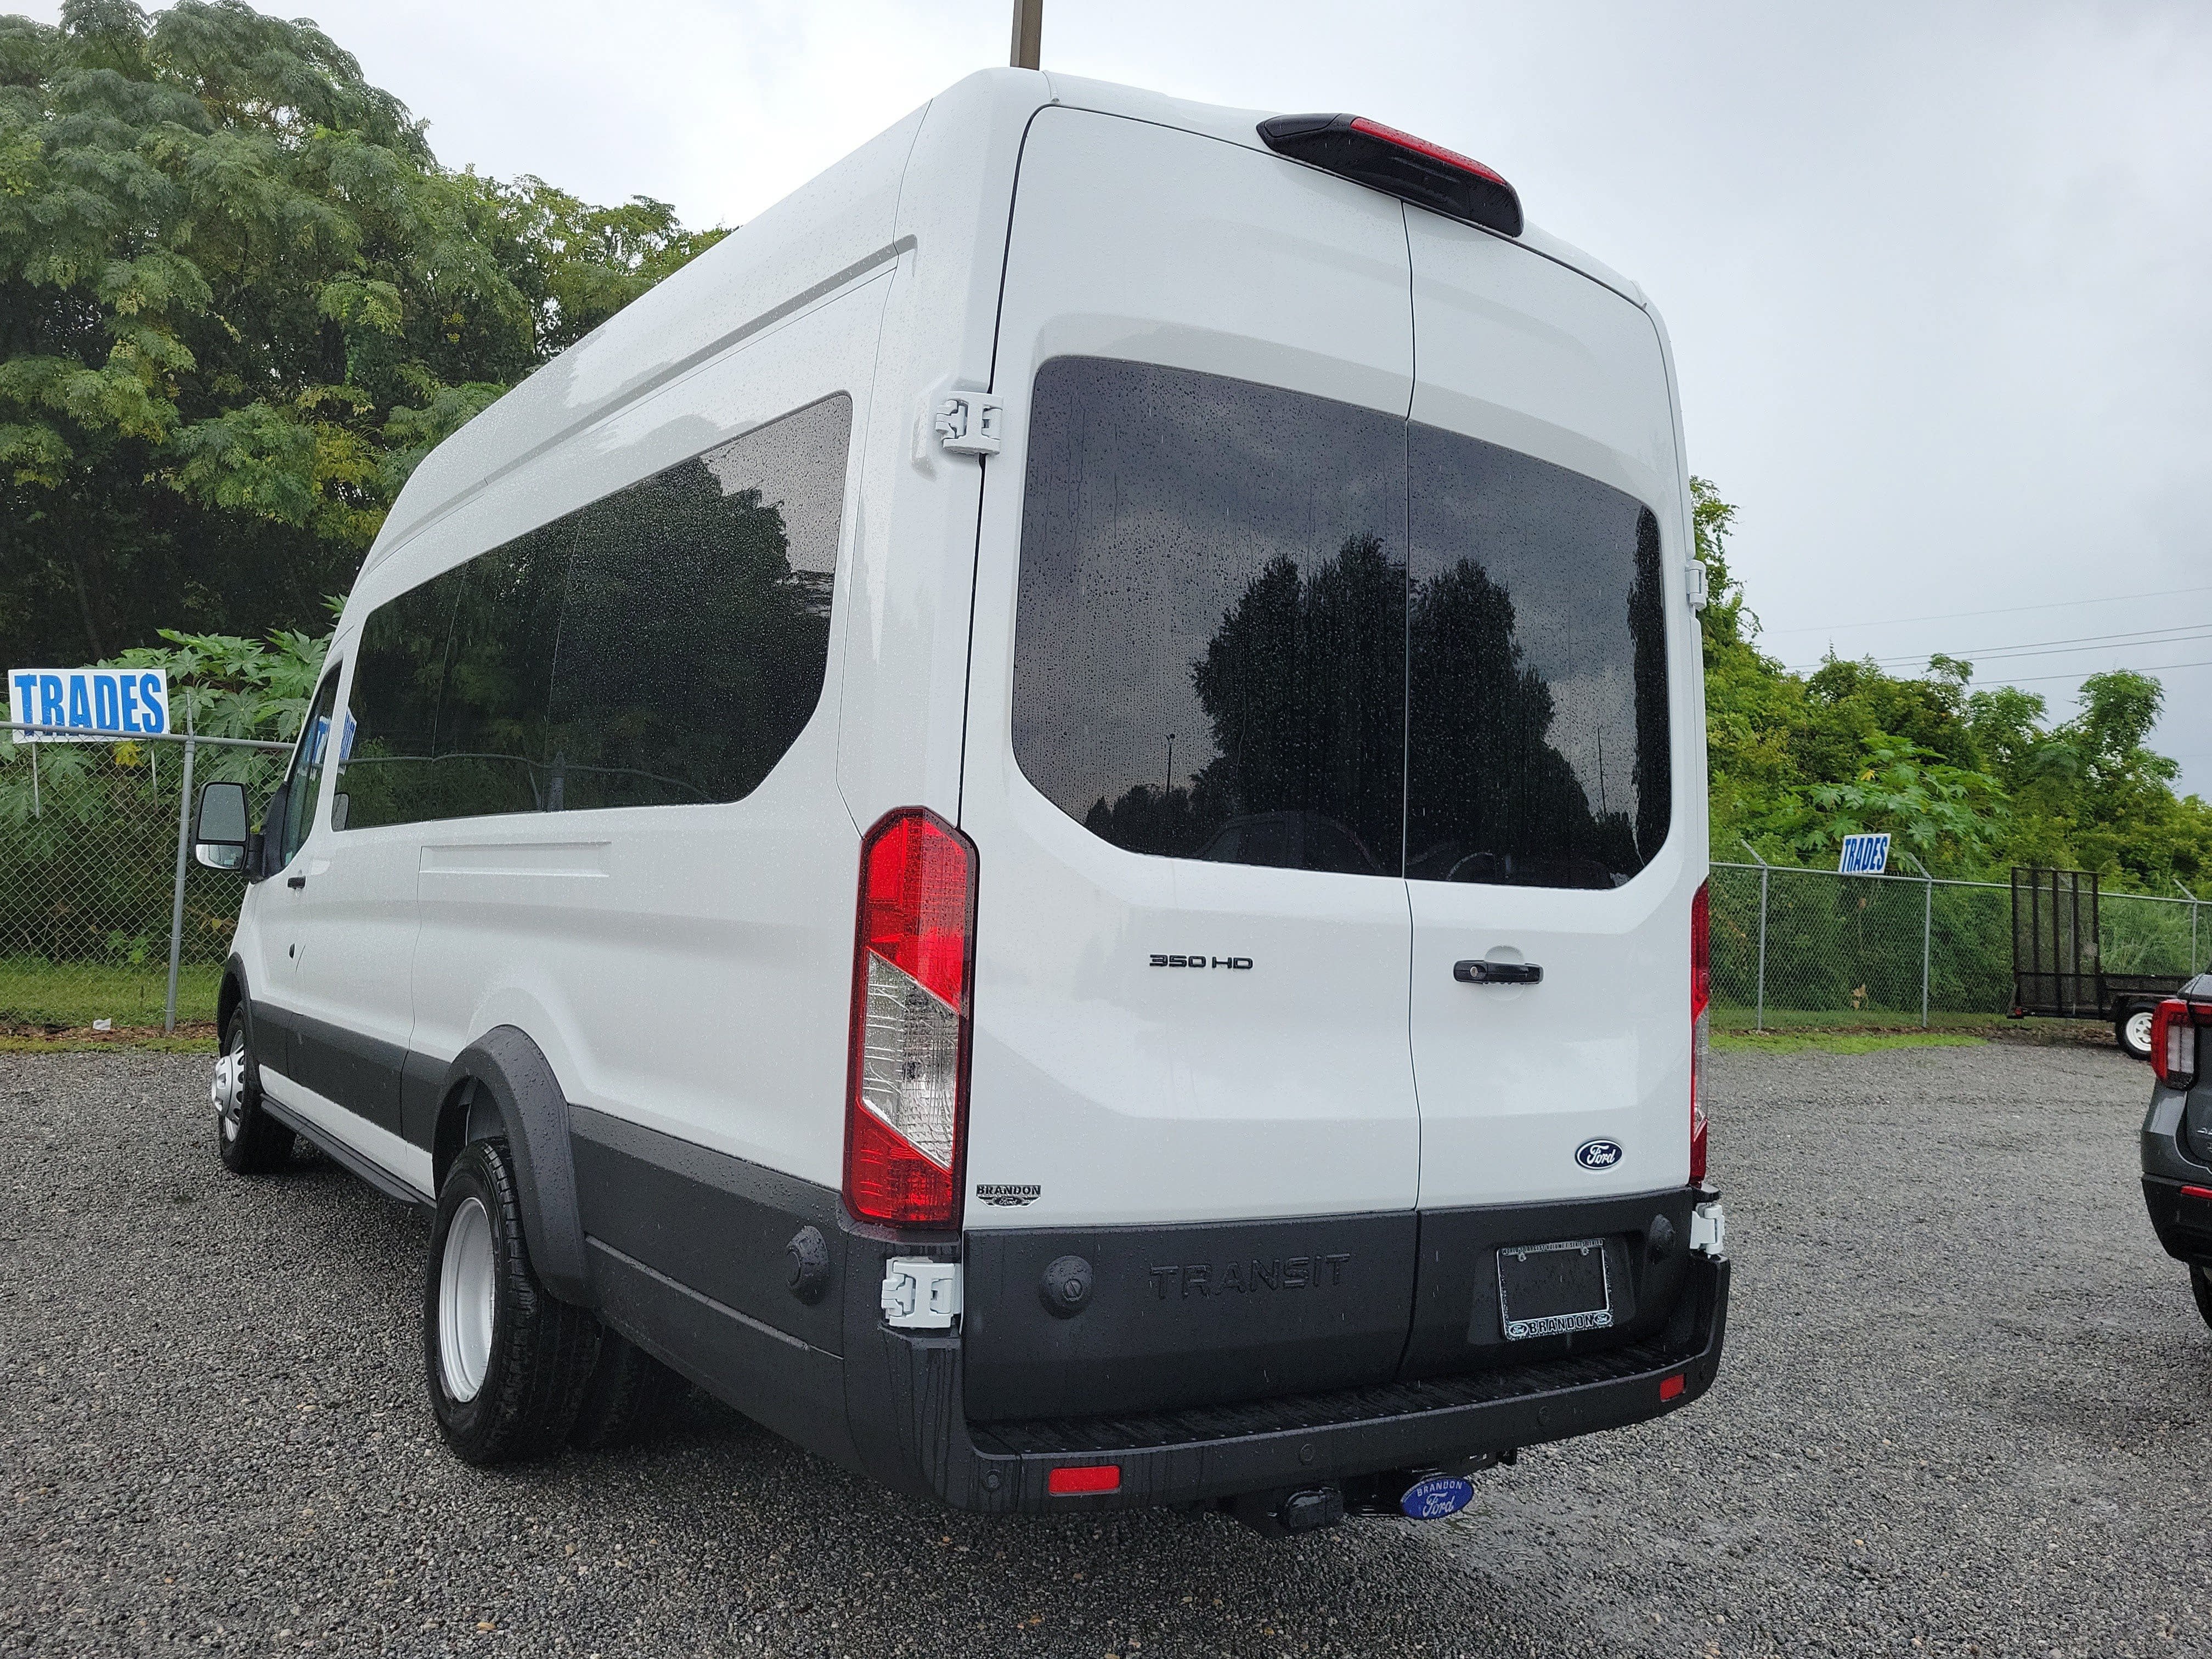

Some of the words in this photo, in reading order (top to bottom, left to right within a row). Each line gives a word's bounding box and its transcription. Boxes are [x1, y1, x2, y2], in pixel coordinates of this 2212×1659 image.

[14, 674, 165, 736] TRADES
[1842, 837, 1888, 872] TRADES
[1149, 955, 1206, 968] 350
[1211, 956, 1253, 969] HD
[1587, 1144, 1616, 1165] Ford
[977, 1185, 1041, 1195] BRANDON
[1149, 1253, 1351, 1299] TRANSIT
[1528, 1314, 1594, 1335] BRANDON
[1417, 1481, 1463, 1497] BRANDON
[1422, 1492, 1455, 1517] Ford
